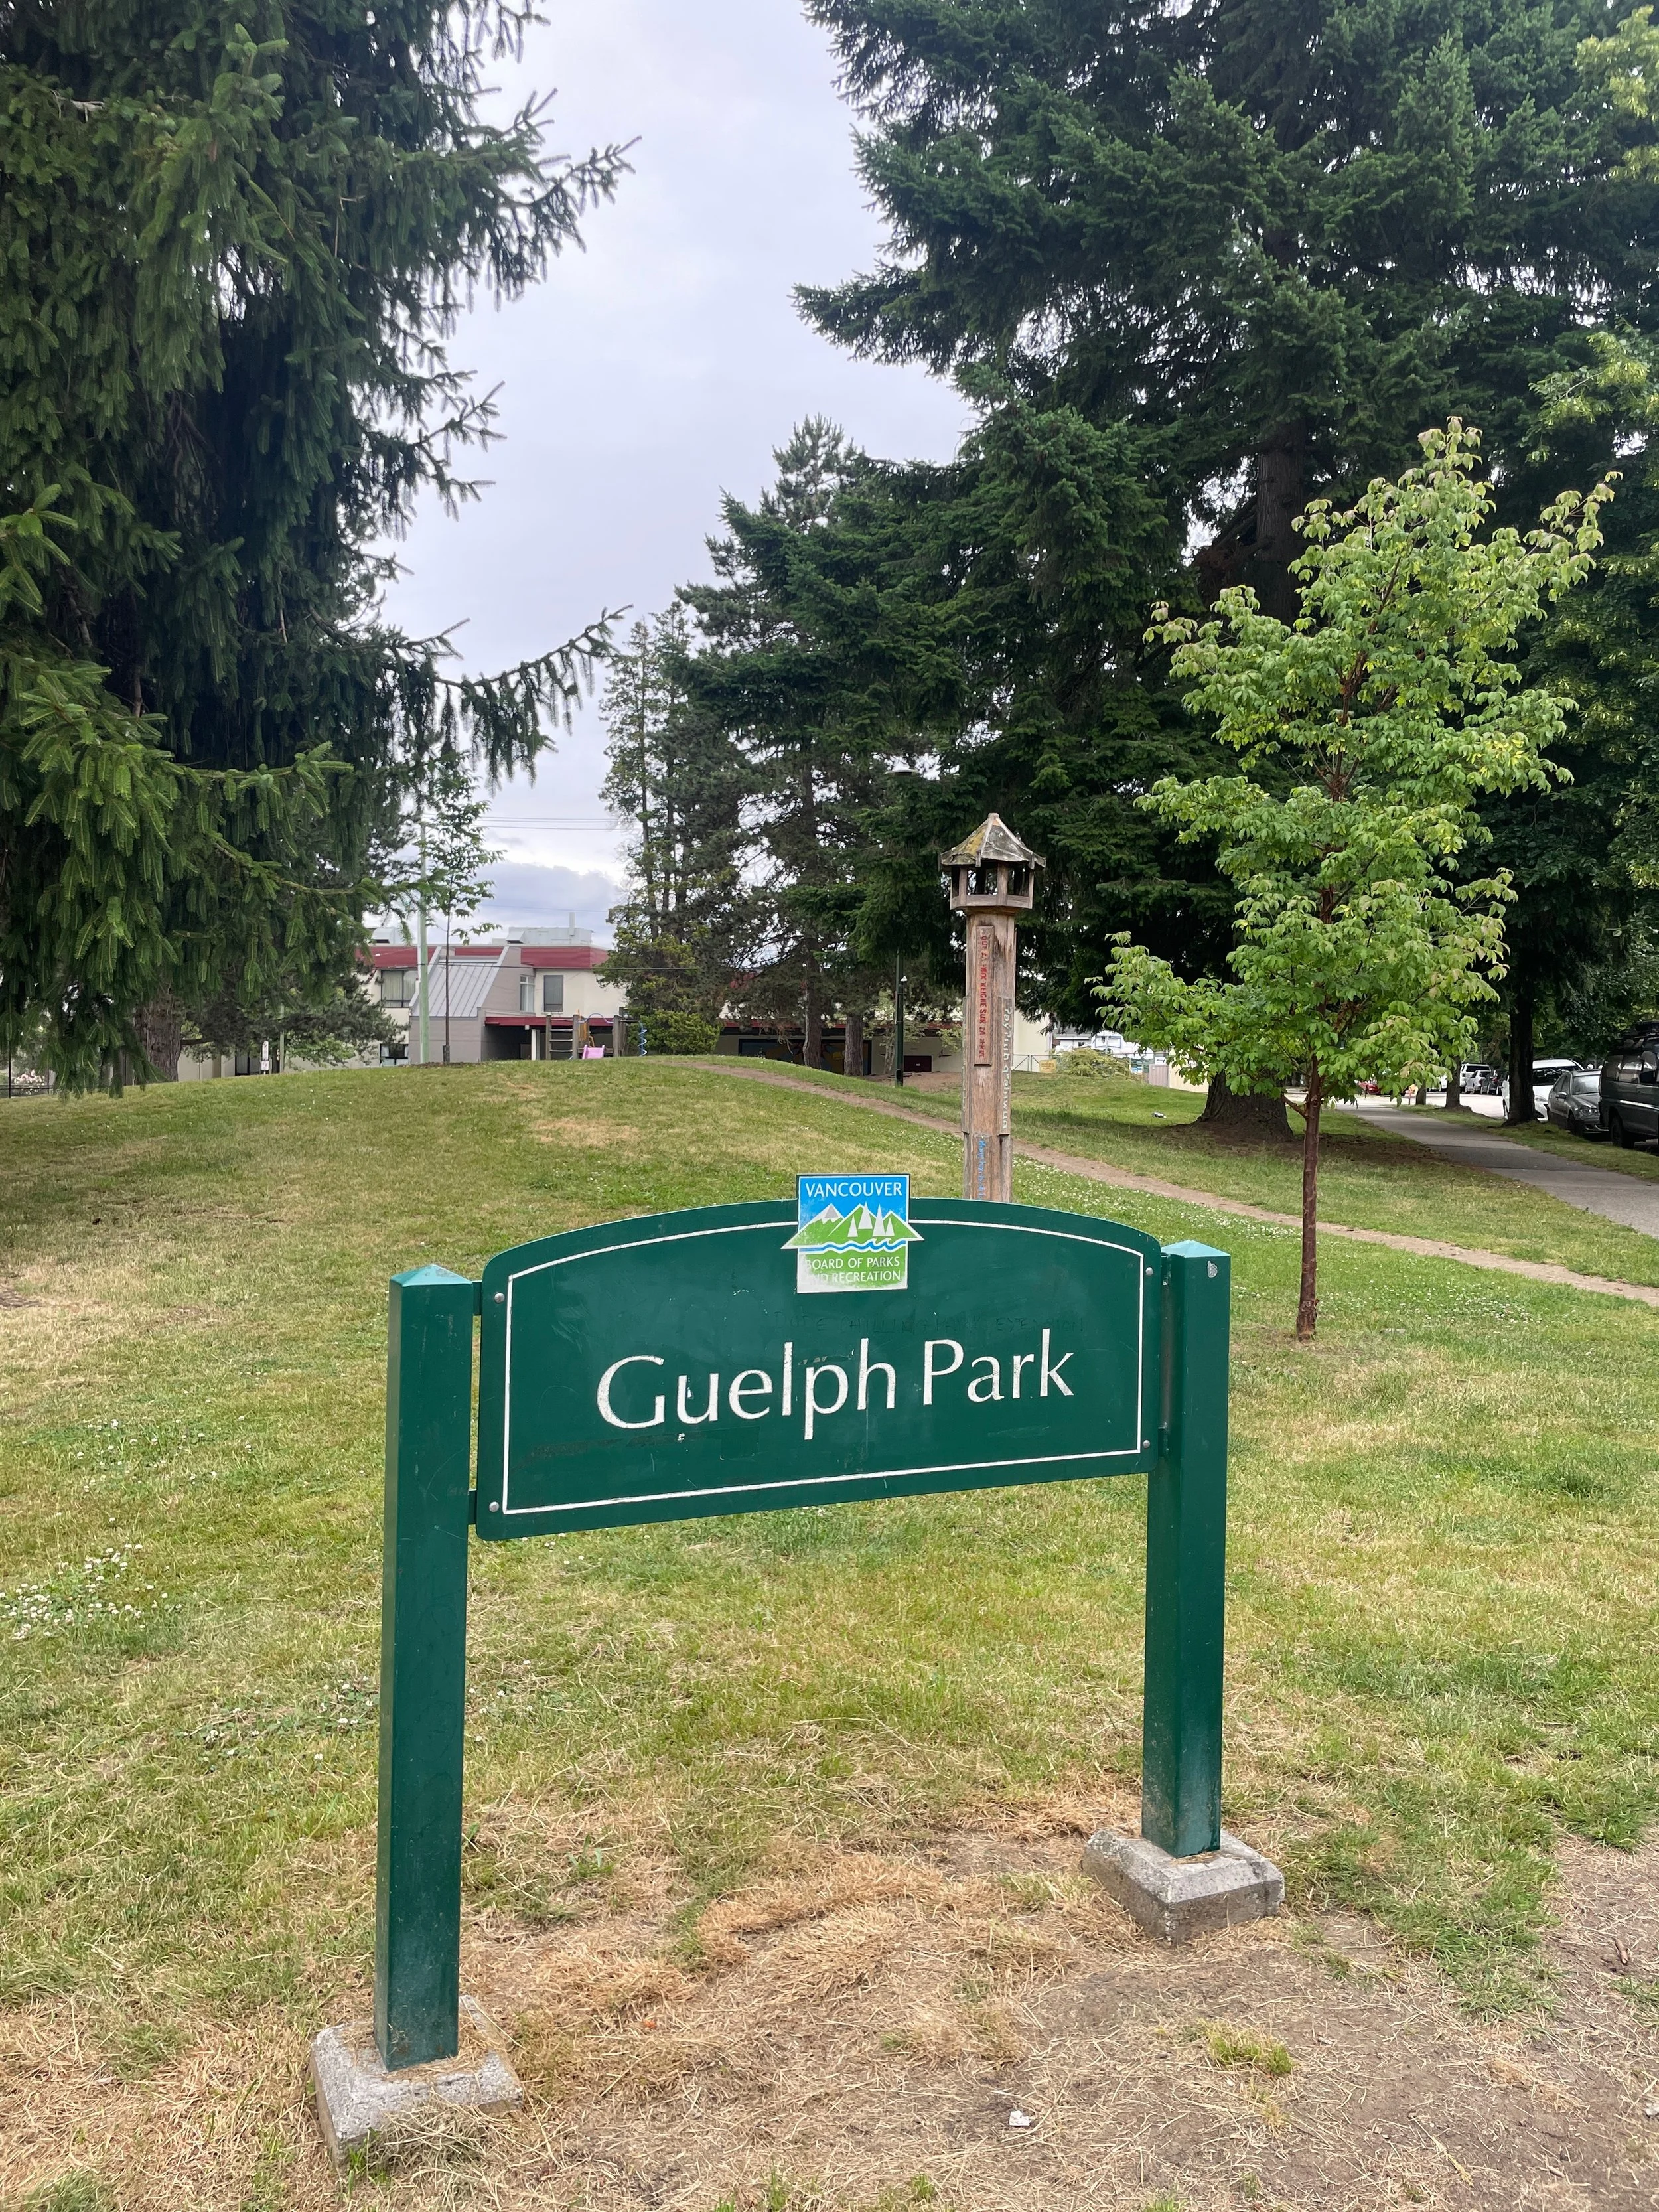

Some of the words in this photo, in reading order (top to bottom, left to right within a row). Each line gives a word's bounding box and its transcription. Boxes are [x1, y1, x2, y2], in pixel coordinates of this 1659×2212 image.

[805, 1181, 903, 1198] VANCOUVER
[806, 1258, 844, 1270] BOARD
[847, 1258, 863, 1269] OF
[867, 1256, 901, 1268] PARKS
[810, 1272, 828, 1284] ND
[831, 1270, 901, 1283] RECREATION
[597, 1337, 896, 1441] Guelph
[922, 1327, 1076, 1406] Park
